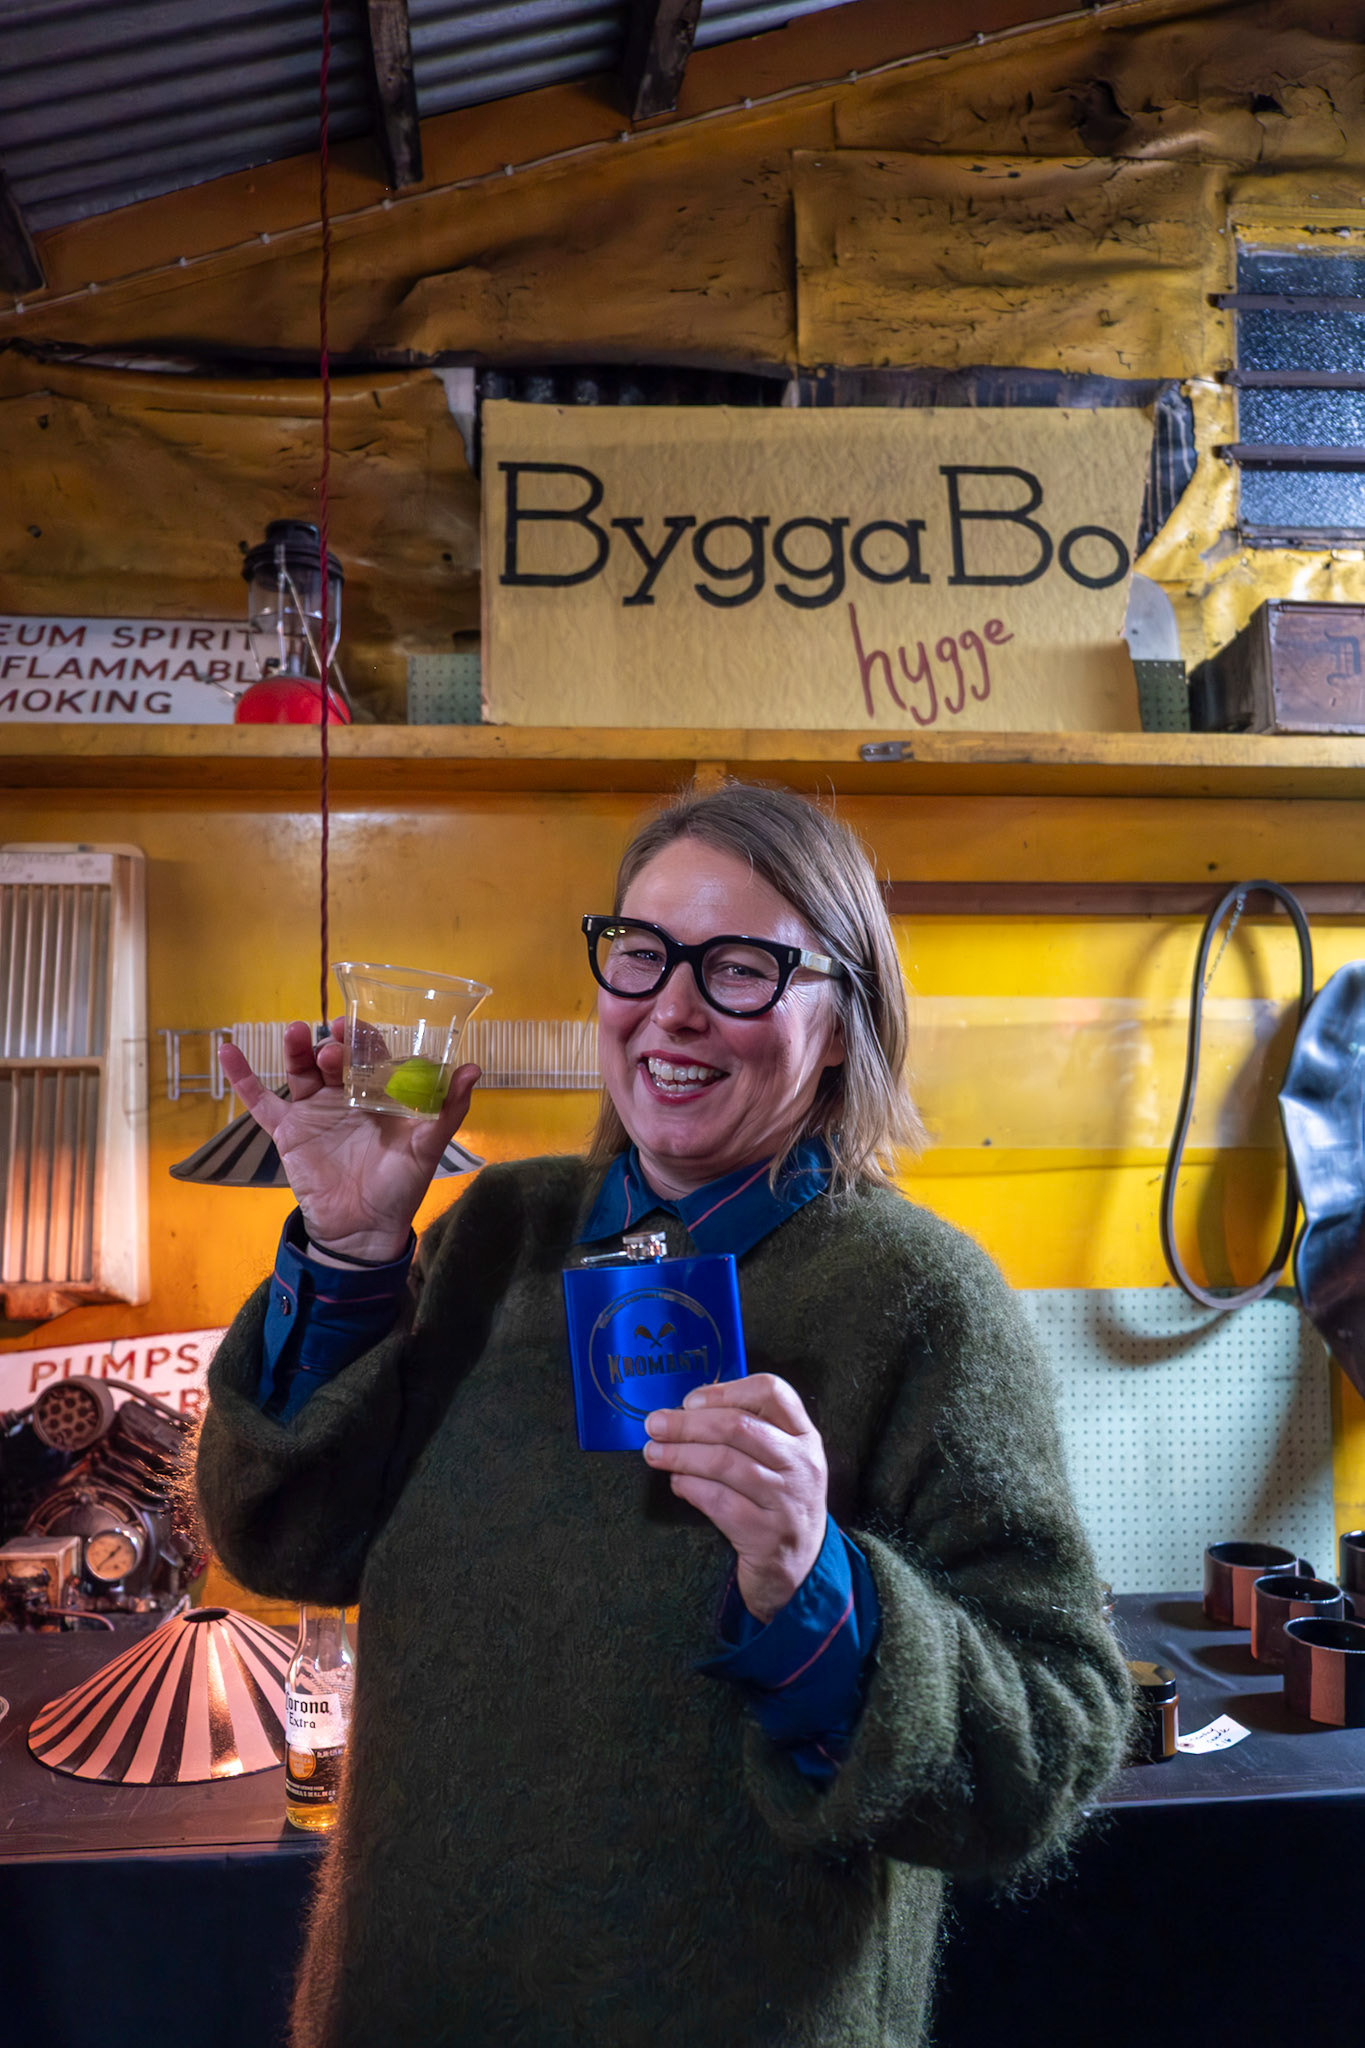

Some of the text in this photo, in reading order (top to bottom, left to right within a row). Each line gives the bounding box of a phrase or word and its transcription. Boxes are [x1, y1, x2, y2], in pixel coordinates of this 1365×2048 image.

[848, 602, 1014, 726] hygge
[29, 1343, 199, 1393] PUMPS
[289, 1711, 316, 1728] Extra
